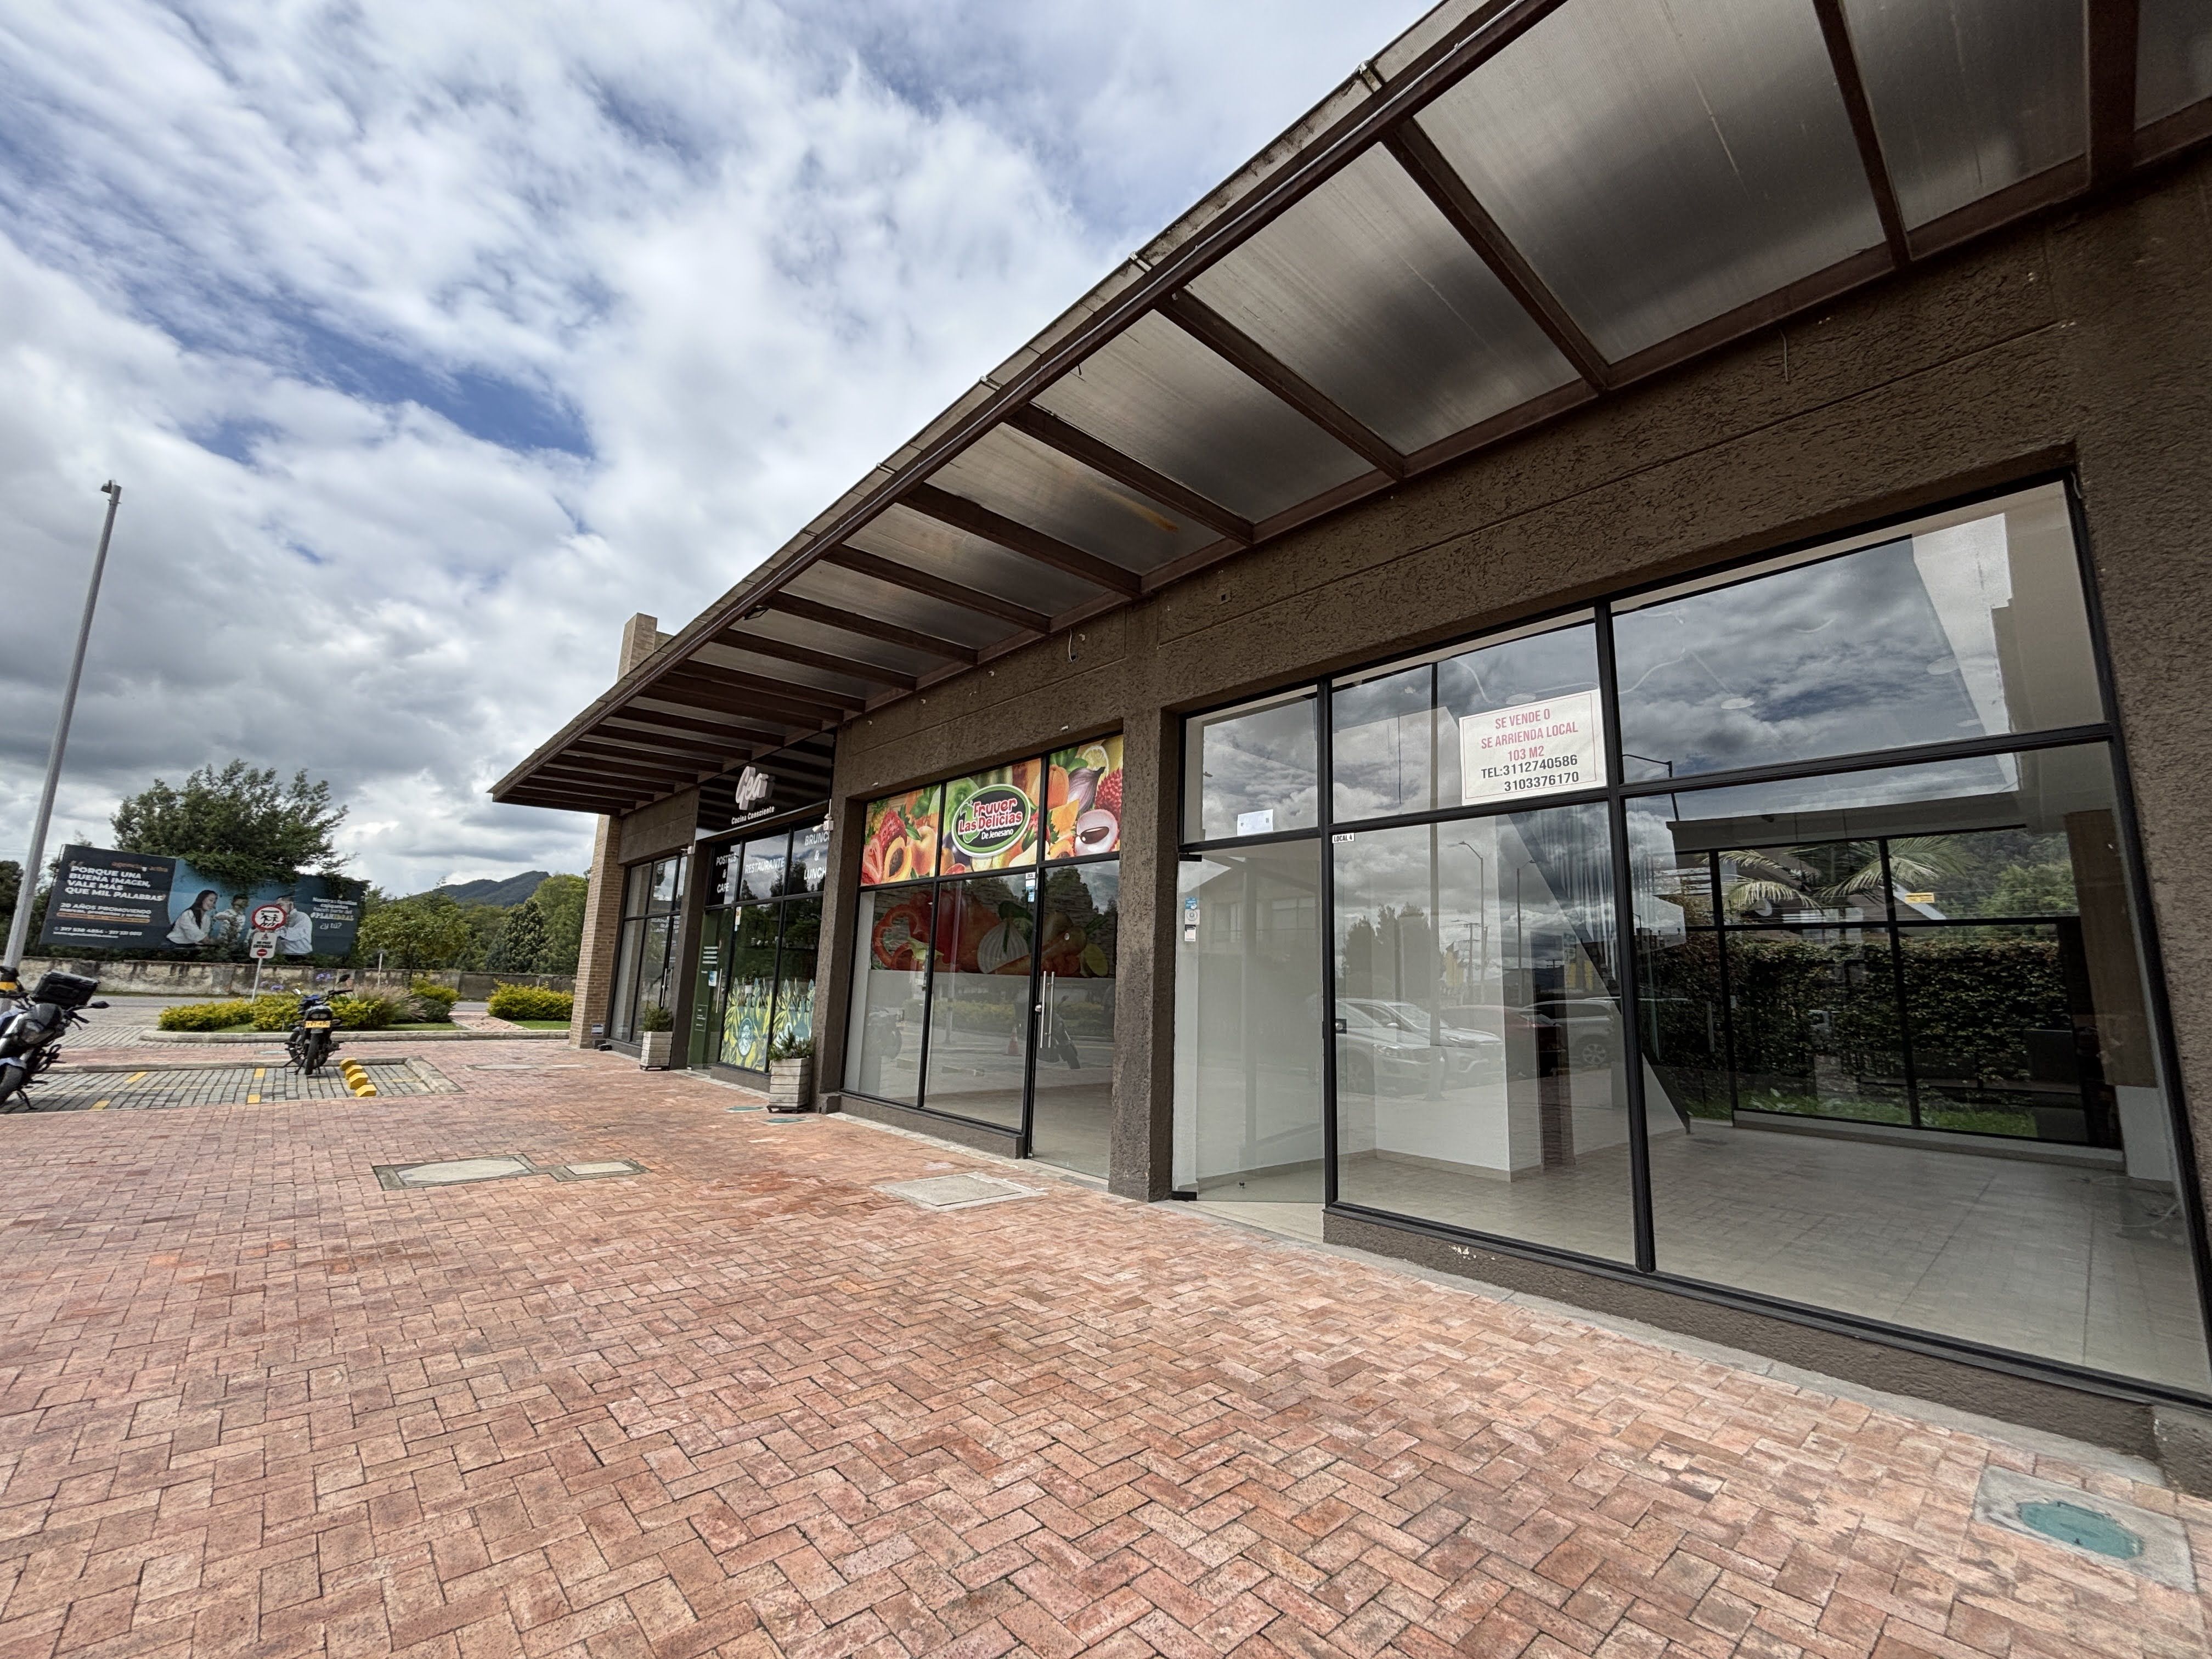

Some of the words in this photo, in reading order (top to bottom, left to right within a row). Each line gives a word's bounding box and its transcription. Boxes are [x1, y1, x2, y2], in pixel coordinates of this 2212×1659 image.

[1495, 716, 1506, 729] SE
[1509, 710, 1541, 727] VENDE
[1481, 737, 1492, 749] SE
[1495, 727, 1543, 747] ARRIENDA
[1546, 721, 1578, 738] LOCAL
[1508, 749, 1526, 761] 103
[1529, 746, 1544, 758] M2
[1481, 754, 1578, 778] TEL:3112740586
[1504, 771, 1579, 792] 3103376170
[958, 820, 977, 834] Las
[978, 811, 1023, 831] Delicias
[805, 831, 830, 846] BRUNC
[981, 832, 989, 840] De
[71, 866, 119, 877] PORQUE
[744, 857, 785, 873] RESTAURANTE
[69, 873, 109, 883] BUENA
[804, 866, 827, 880] LUNCH
[67, 879, 97, 888] VALE
